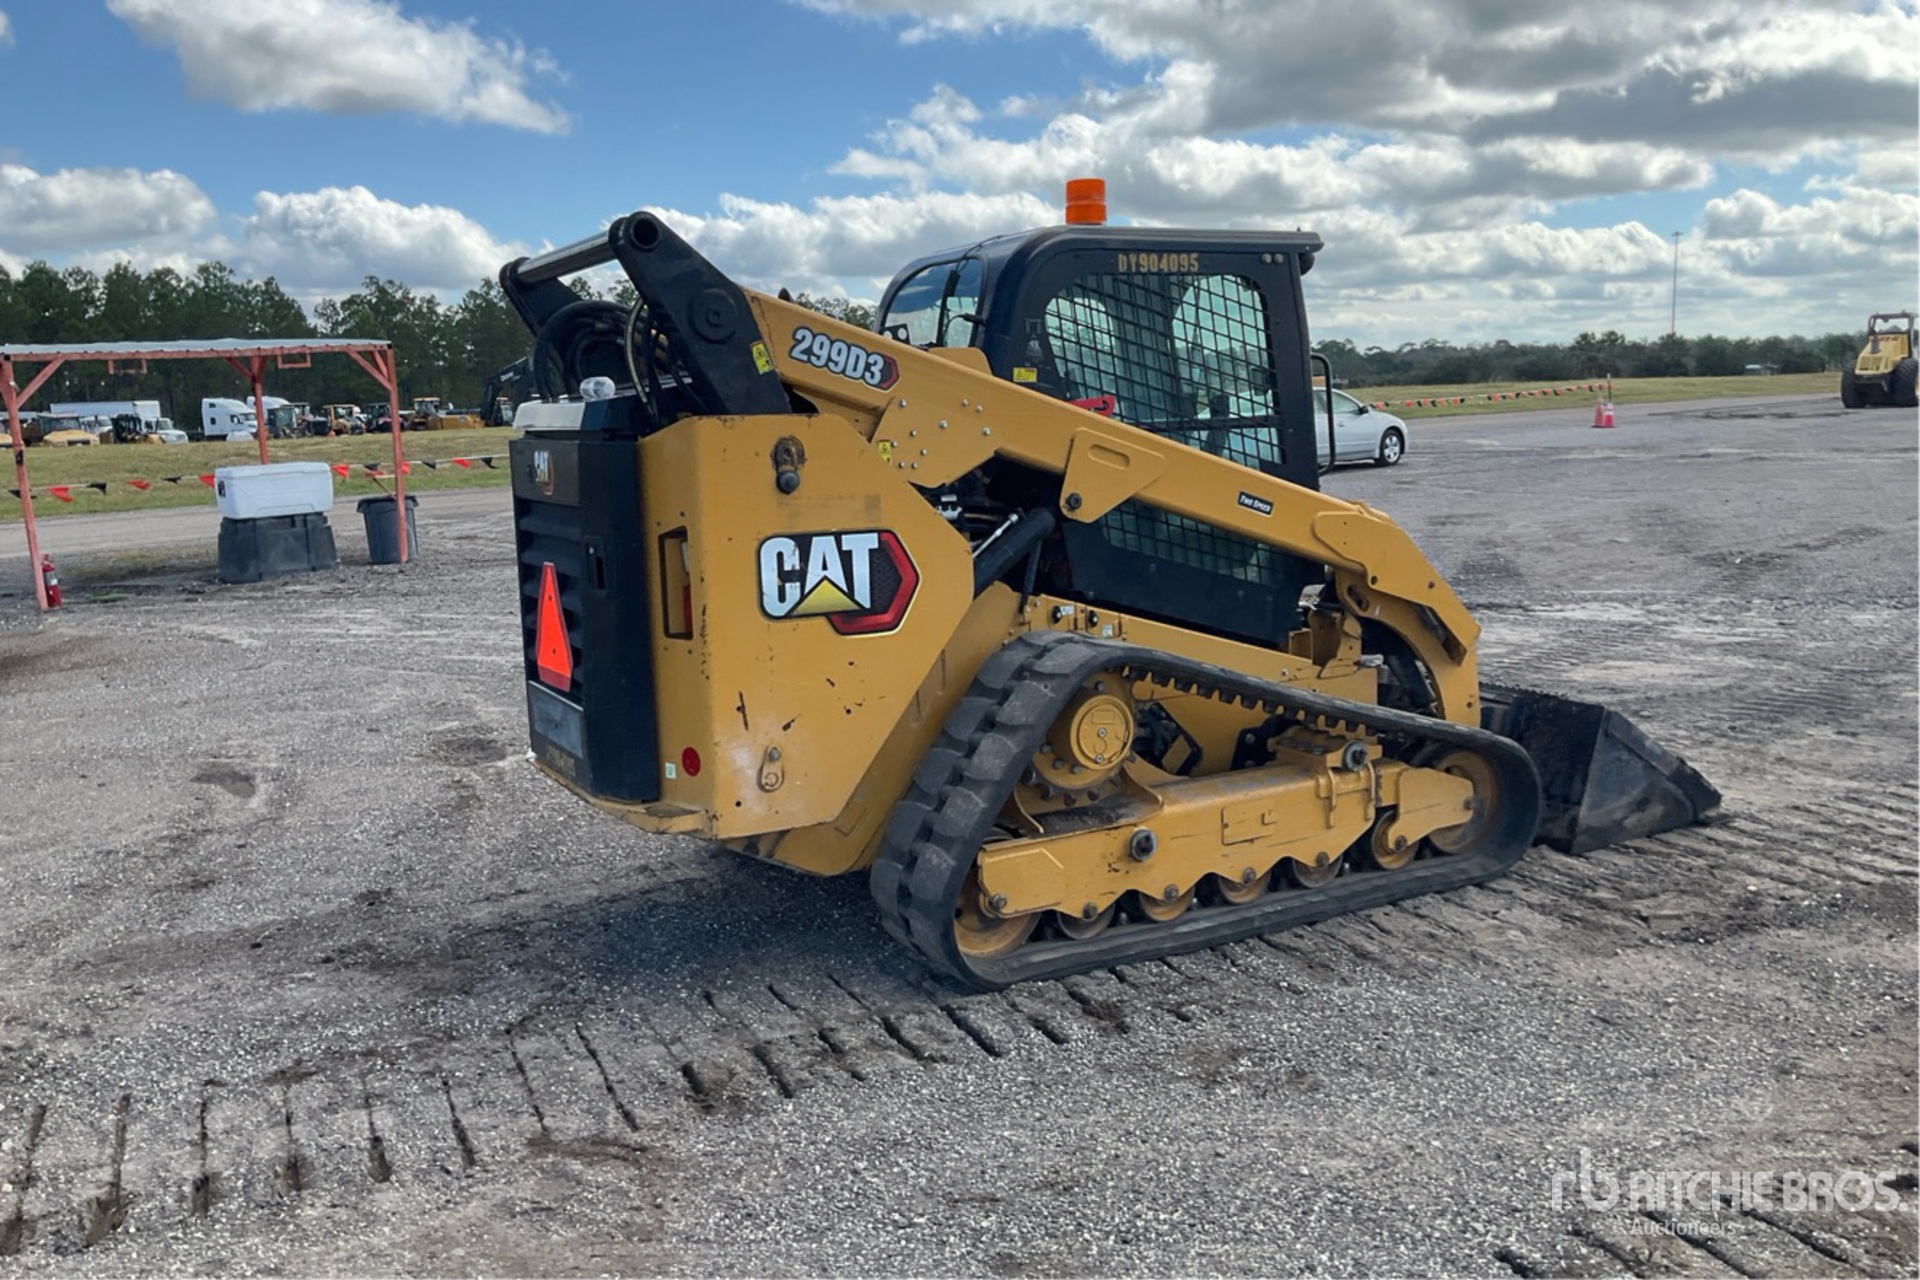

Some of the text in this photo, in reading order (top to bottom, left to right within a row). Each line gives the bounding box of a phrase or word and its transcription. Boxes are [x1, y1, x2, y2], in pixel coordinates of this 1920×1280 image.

[1117, 253, 1199, 272] DY904095
[790, 327, 885, 386] 299D3
[533, 450, 549, 482] CAT
[760, 532, 879, 617] CAT
